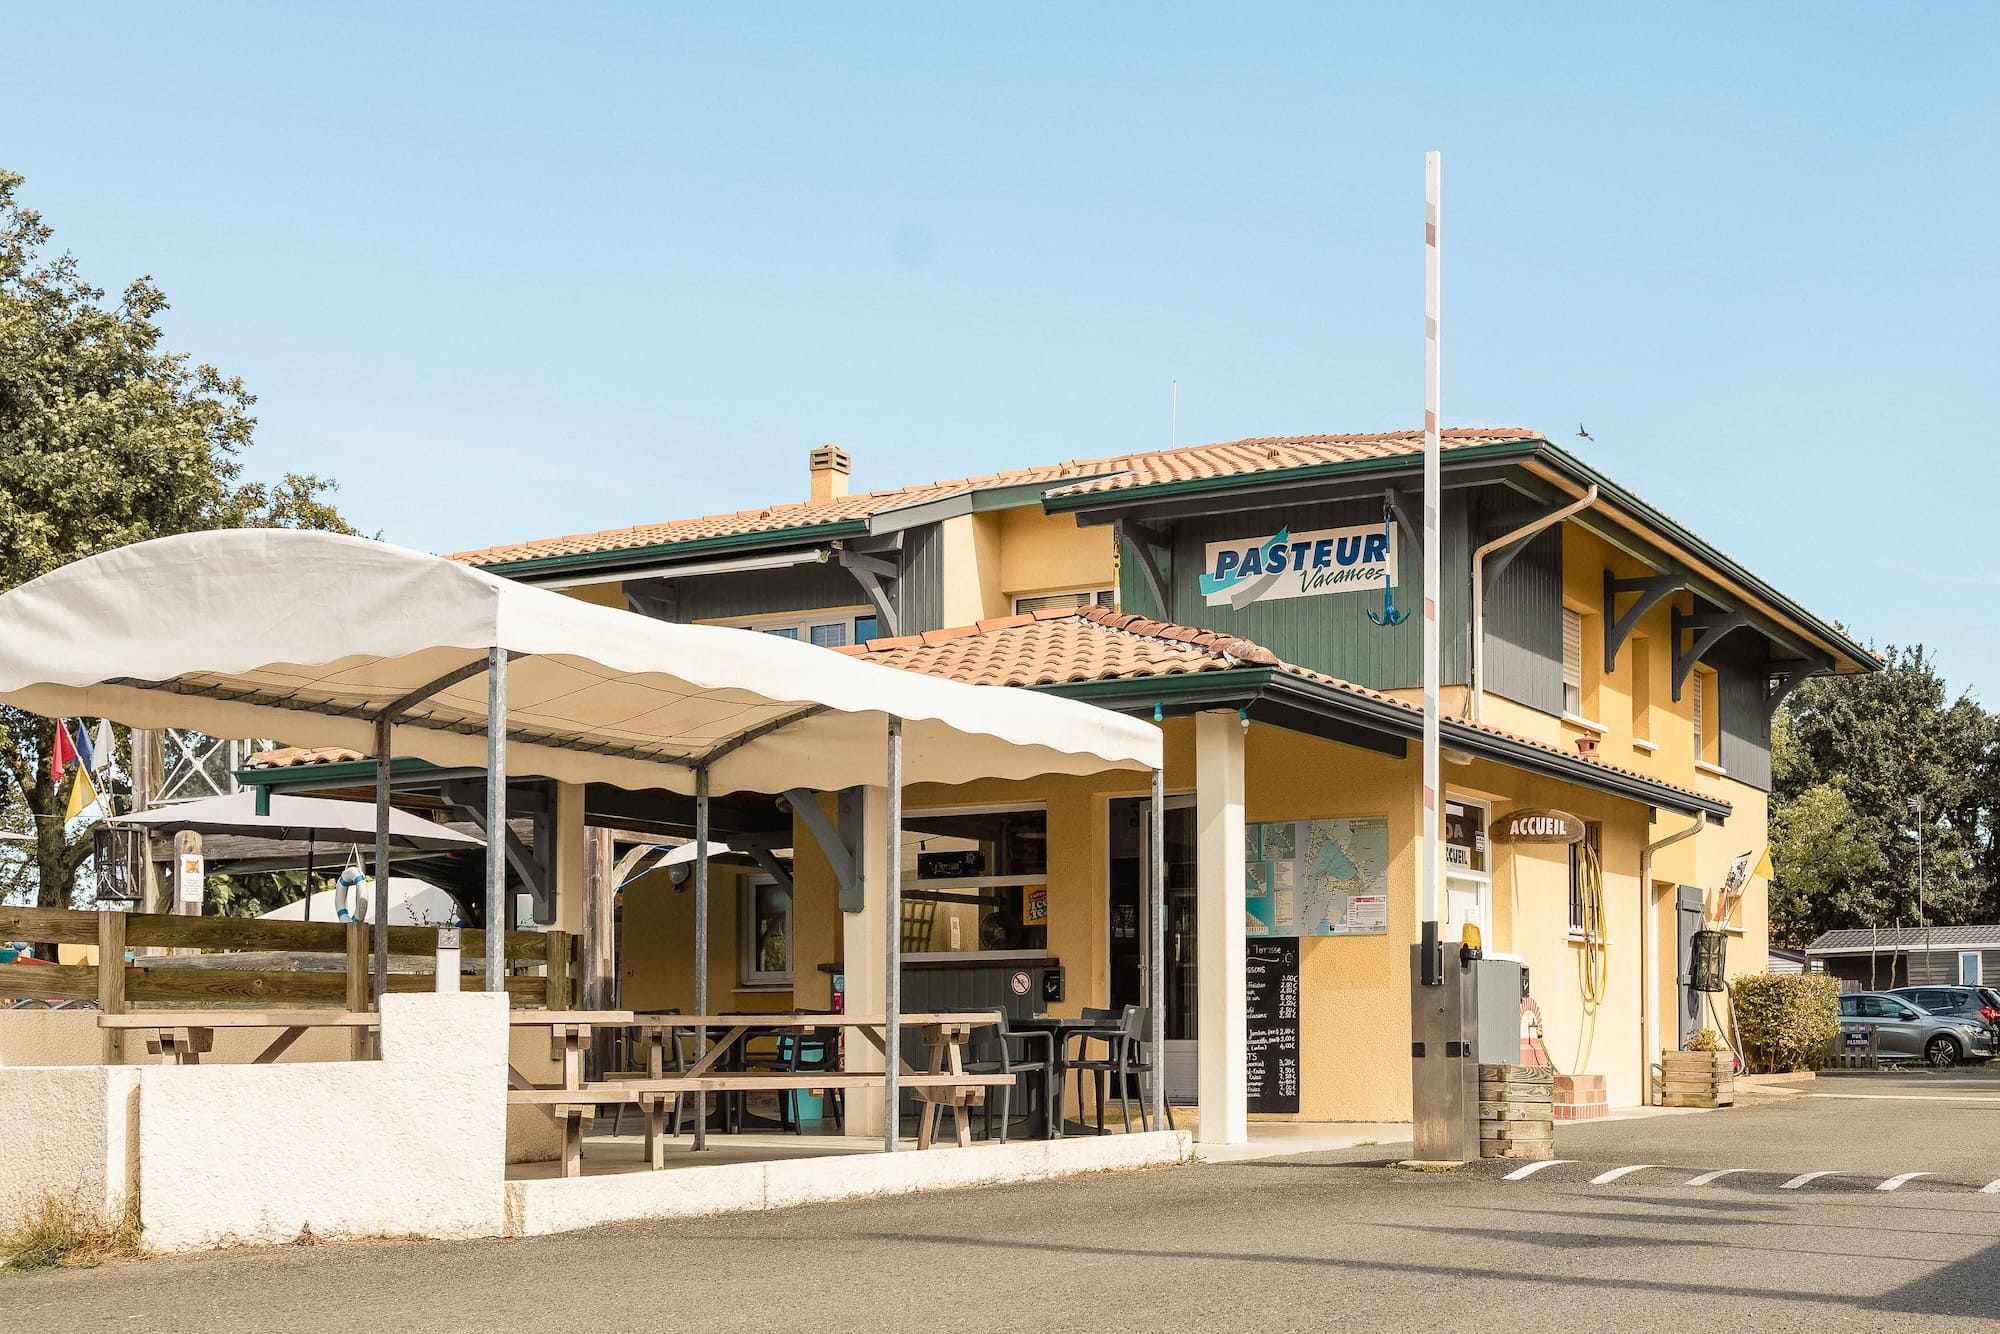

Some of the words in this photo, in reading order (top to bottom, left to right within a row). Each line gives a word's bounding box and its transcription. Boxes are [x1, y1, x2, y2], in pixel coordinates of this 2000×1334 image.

[1214, 533, 1389, 580] PASTEUR
[1300, 565, 1388, 593] Vacances
[1509, 816, 1567, 835] ACCUEIL
[1446, 847, 1467, 865] CCUEIL
[1247, 965, 1266, 974] SSONS
